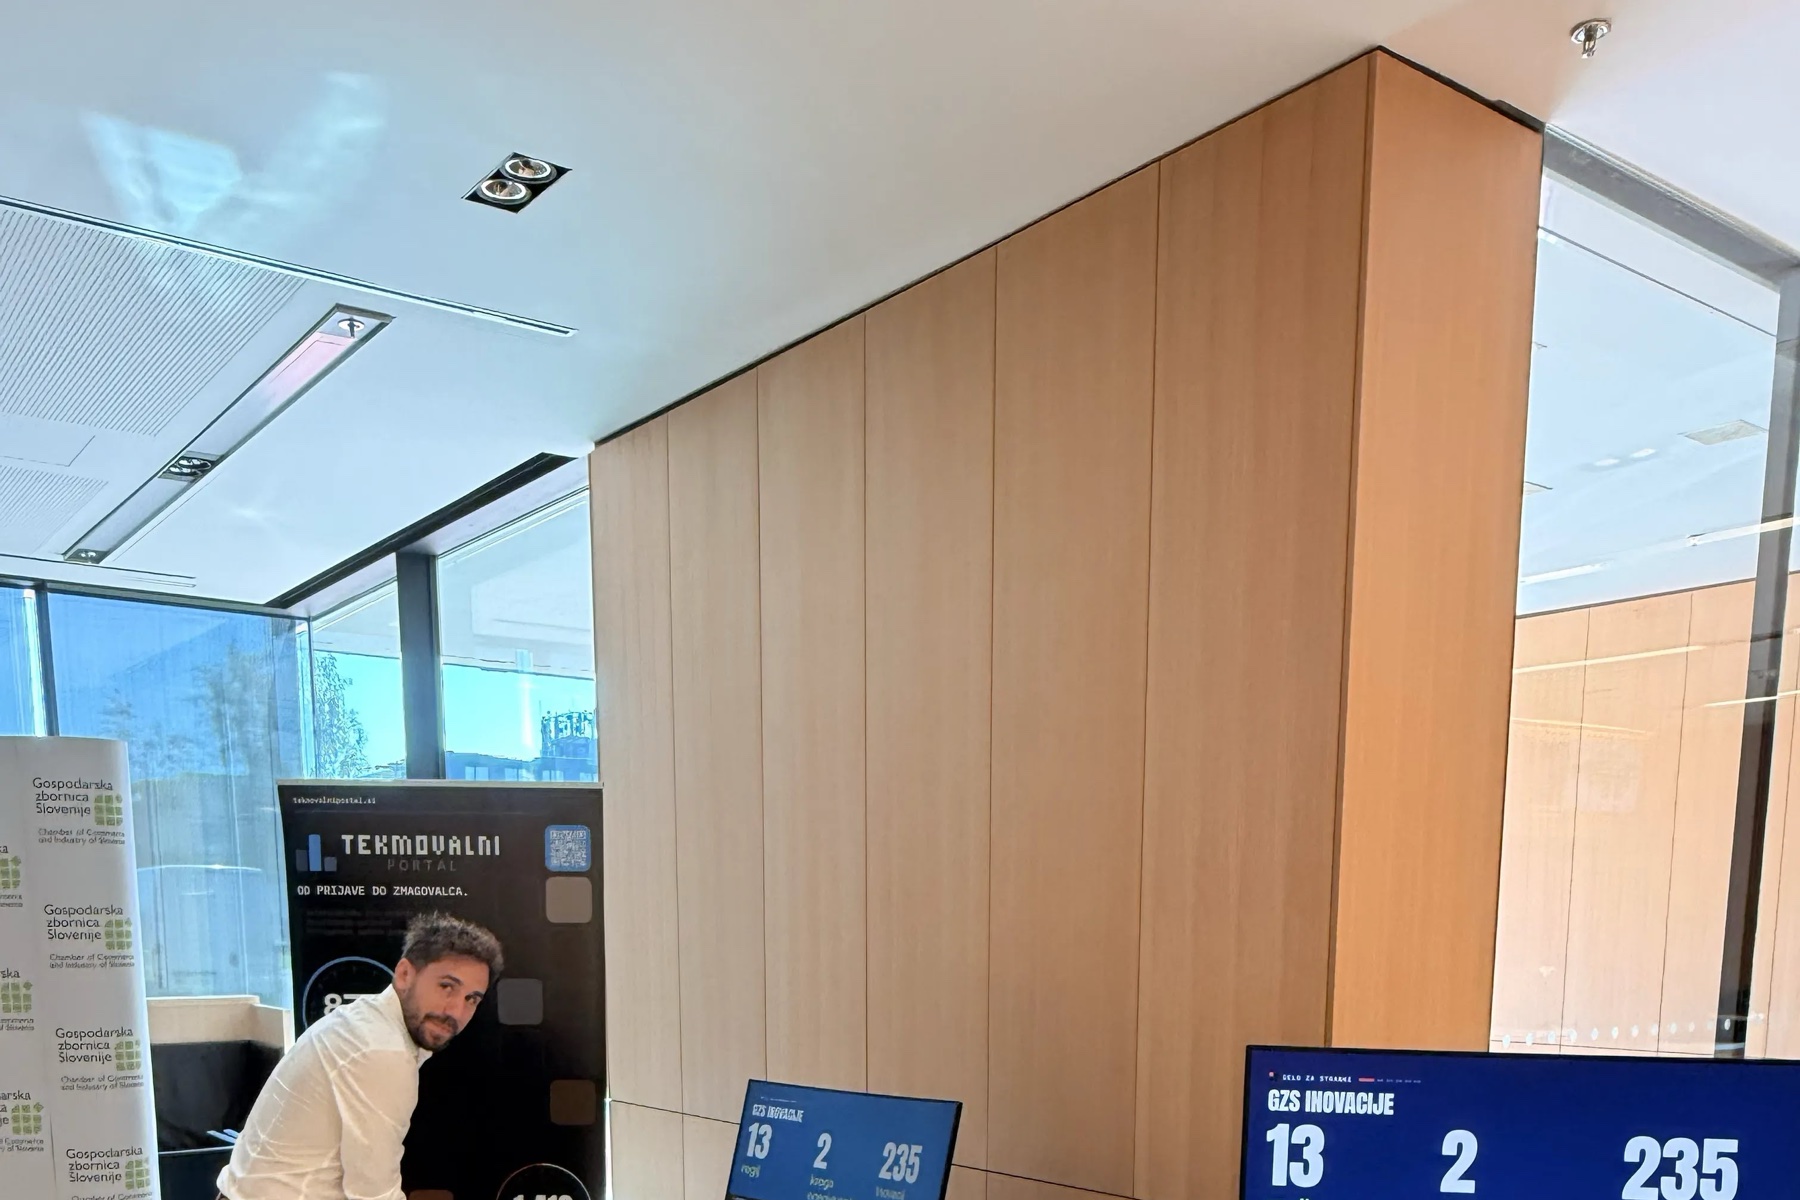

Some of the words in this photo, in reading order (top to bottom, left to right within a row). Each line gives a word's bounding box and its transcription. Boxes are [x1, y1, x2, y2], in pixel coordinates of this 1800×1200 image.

[32, 777, 113, 791] Gospodarska
[35, 790, 89, 802] zbornica
[36, 802, 91, 818] Slovenije
[341, 834, 500, 856] TEKMOVALNI
[387, 859, 457, 872] PORTAL
[297, 885, 311, 896] OD
[316, 885, 365, 896] PRIJAVE
[372, 885, 387, 896] DO
[393, 886, 468, 896] ZMAGOVALCA.
[44, 904, 123, 917] Gospodarska
[47, 917, 100, 928] zbornica
[47, 928, 102, 942] Slovenije
[55, 1026, 133, 1041] Gospodarska
[58, 1040, 110, 1050] zbornica
[58, 1051, 112, 1064] Slovenije
[1267, 1088, 1301, 1112] GZS
[1305, 1090, 1395, 1115] INOVACIJE
[746, 1122, 773, 1160] 13
[66, 1146, 143, 1161] Gospodarska
[813, 1132, 832, 1170] 2
[1266, 1123, 1325, 1188] 13
[68, 1160, 120, 1171] zbornica
[878, 1142, 923, 1184] 235
[1440, 1129, 1478, 1194] 2
[69, 1171, 122, 1184] Slovenije
